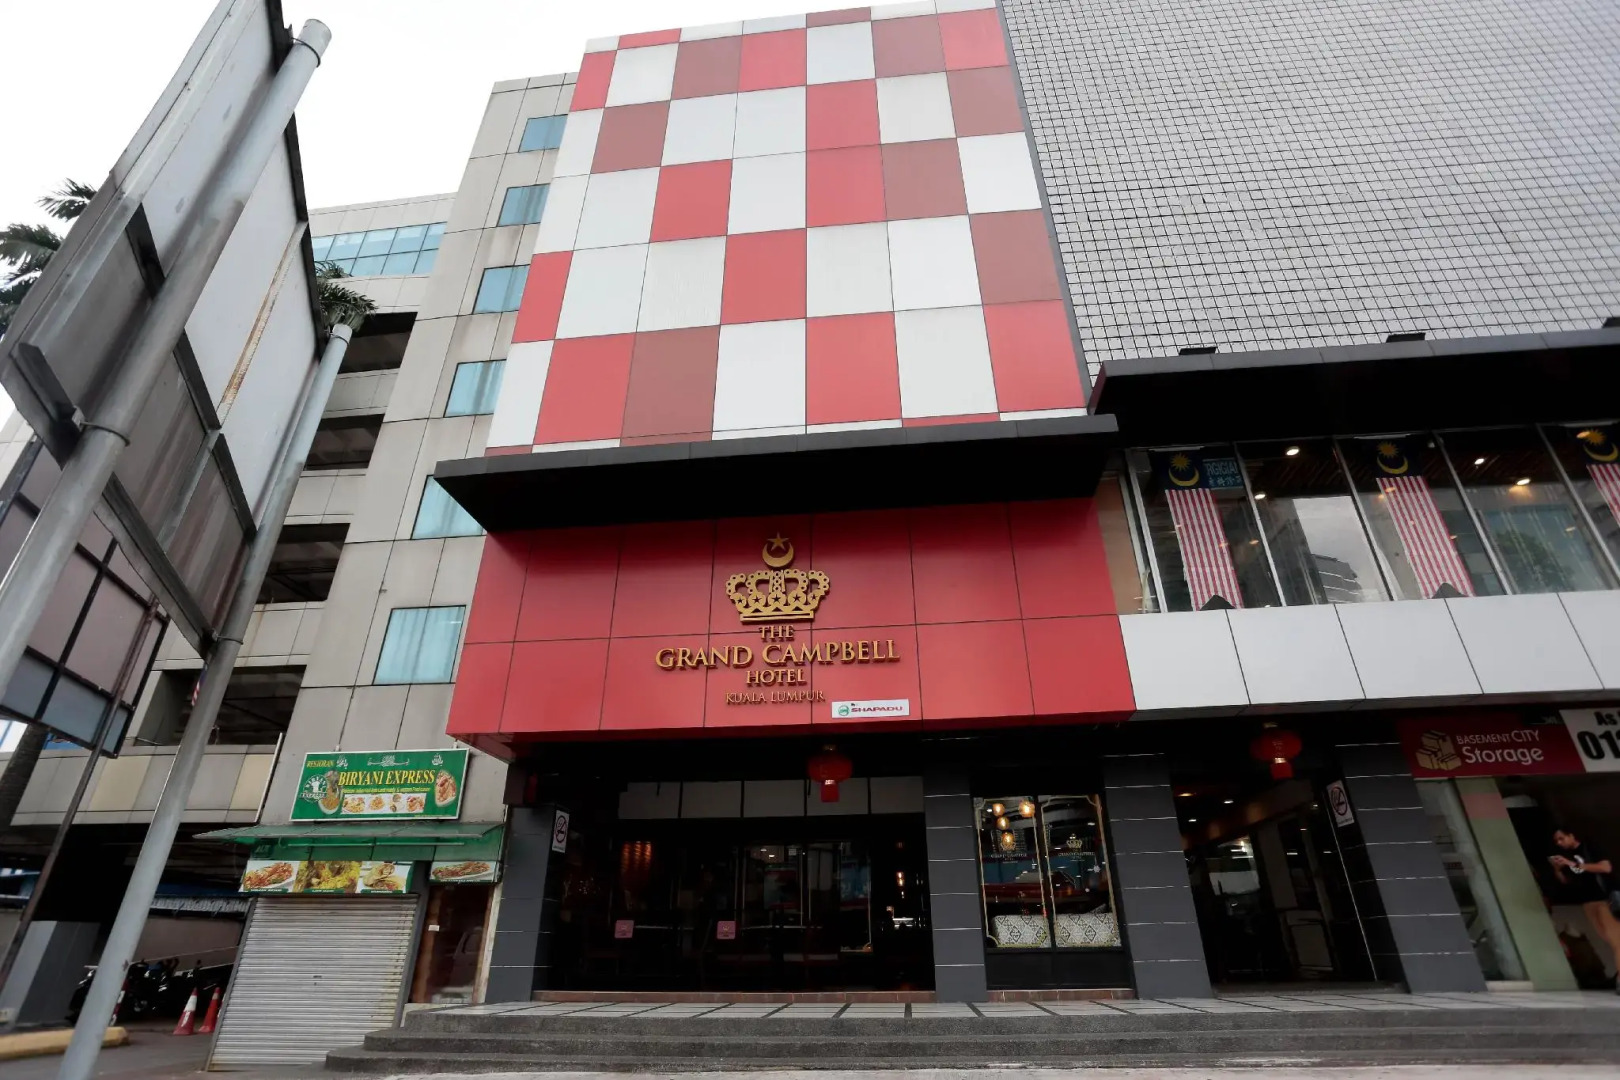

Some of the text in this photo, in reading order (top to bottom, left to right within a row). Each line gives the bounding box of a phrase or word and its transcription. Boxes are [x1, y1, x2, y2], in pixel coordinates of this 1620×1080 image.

[759, 625, 795, 641] THE
[656, 640, 900, 669] GRAND CAMPBELL
[746, 669, 807, 686] HOTEL
[726, 690, 825, 704] KUALA LUMPUR
[1594, 711, 1617, 726] As
[1456, 730, 1541, 745] BASEMENT CITY
[1577, 730, 1620, 760] 01
[1462, 747, 1544, 765] Storage
[338, 770, 385, 786] BIRYANI
[385, 769, 436, 785] EXPRESS
